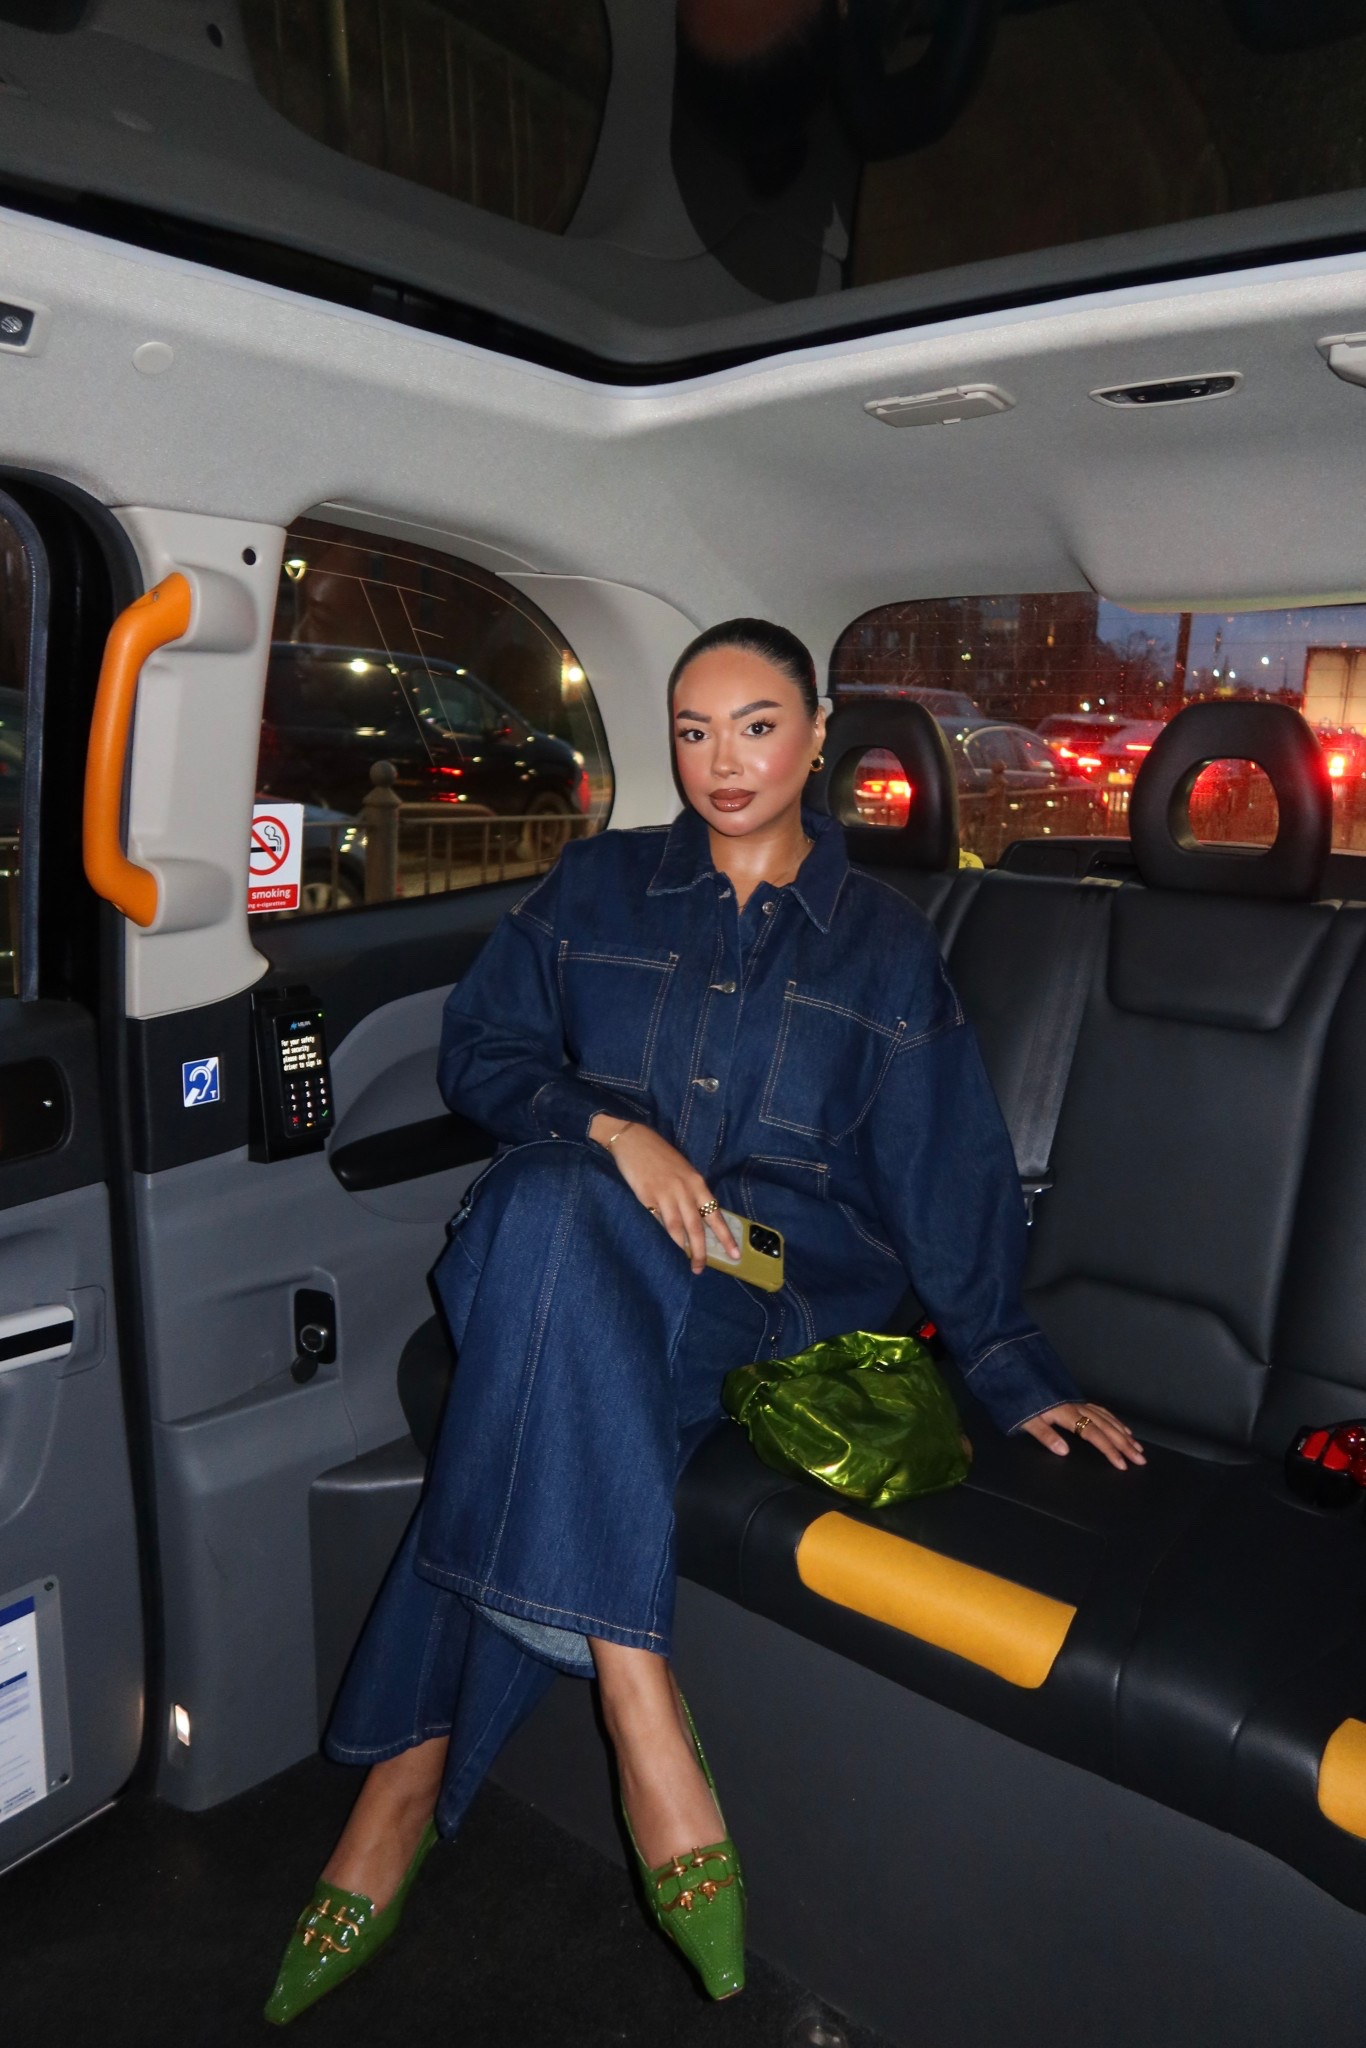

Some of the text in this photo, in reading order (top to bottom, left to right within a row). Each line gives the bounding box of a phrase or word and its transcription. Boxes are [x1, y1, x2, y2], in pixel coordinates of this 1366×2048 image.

[252, 888, 291, 899] smoking
[290, 1039, 300, 1047] your
[301, 1036, 315, 1044] safety
[282, 1045, 310, 1055] and security
[283, 1055, 297, 1064] please
[307, 1052, 317, 1060] your
[284, 1063, 298, 1071] driver
[306, 1060, 316, 1068] sign
[209, 1090, 217, 1099] T
